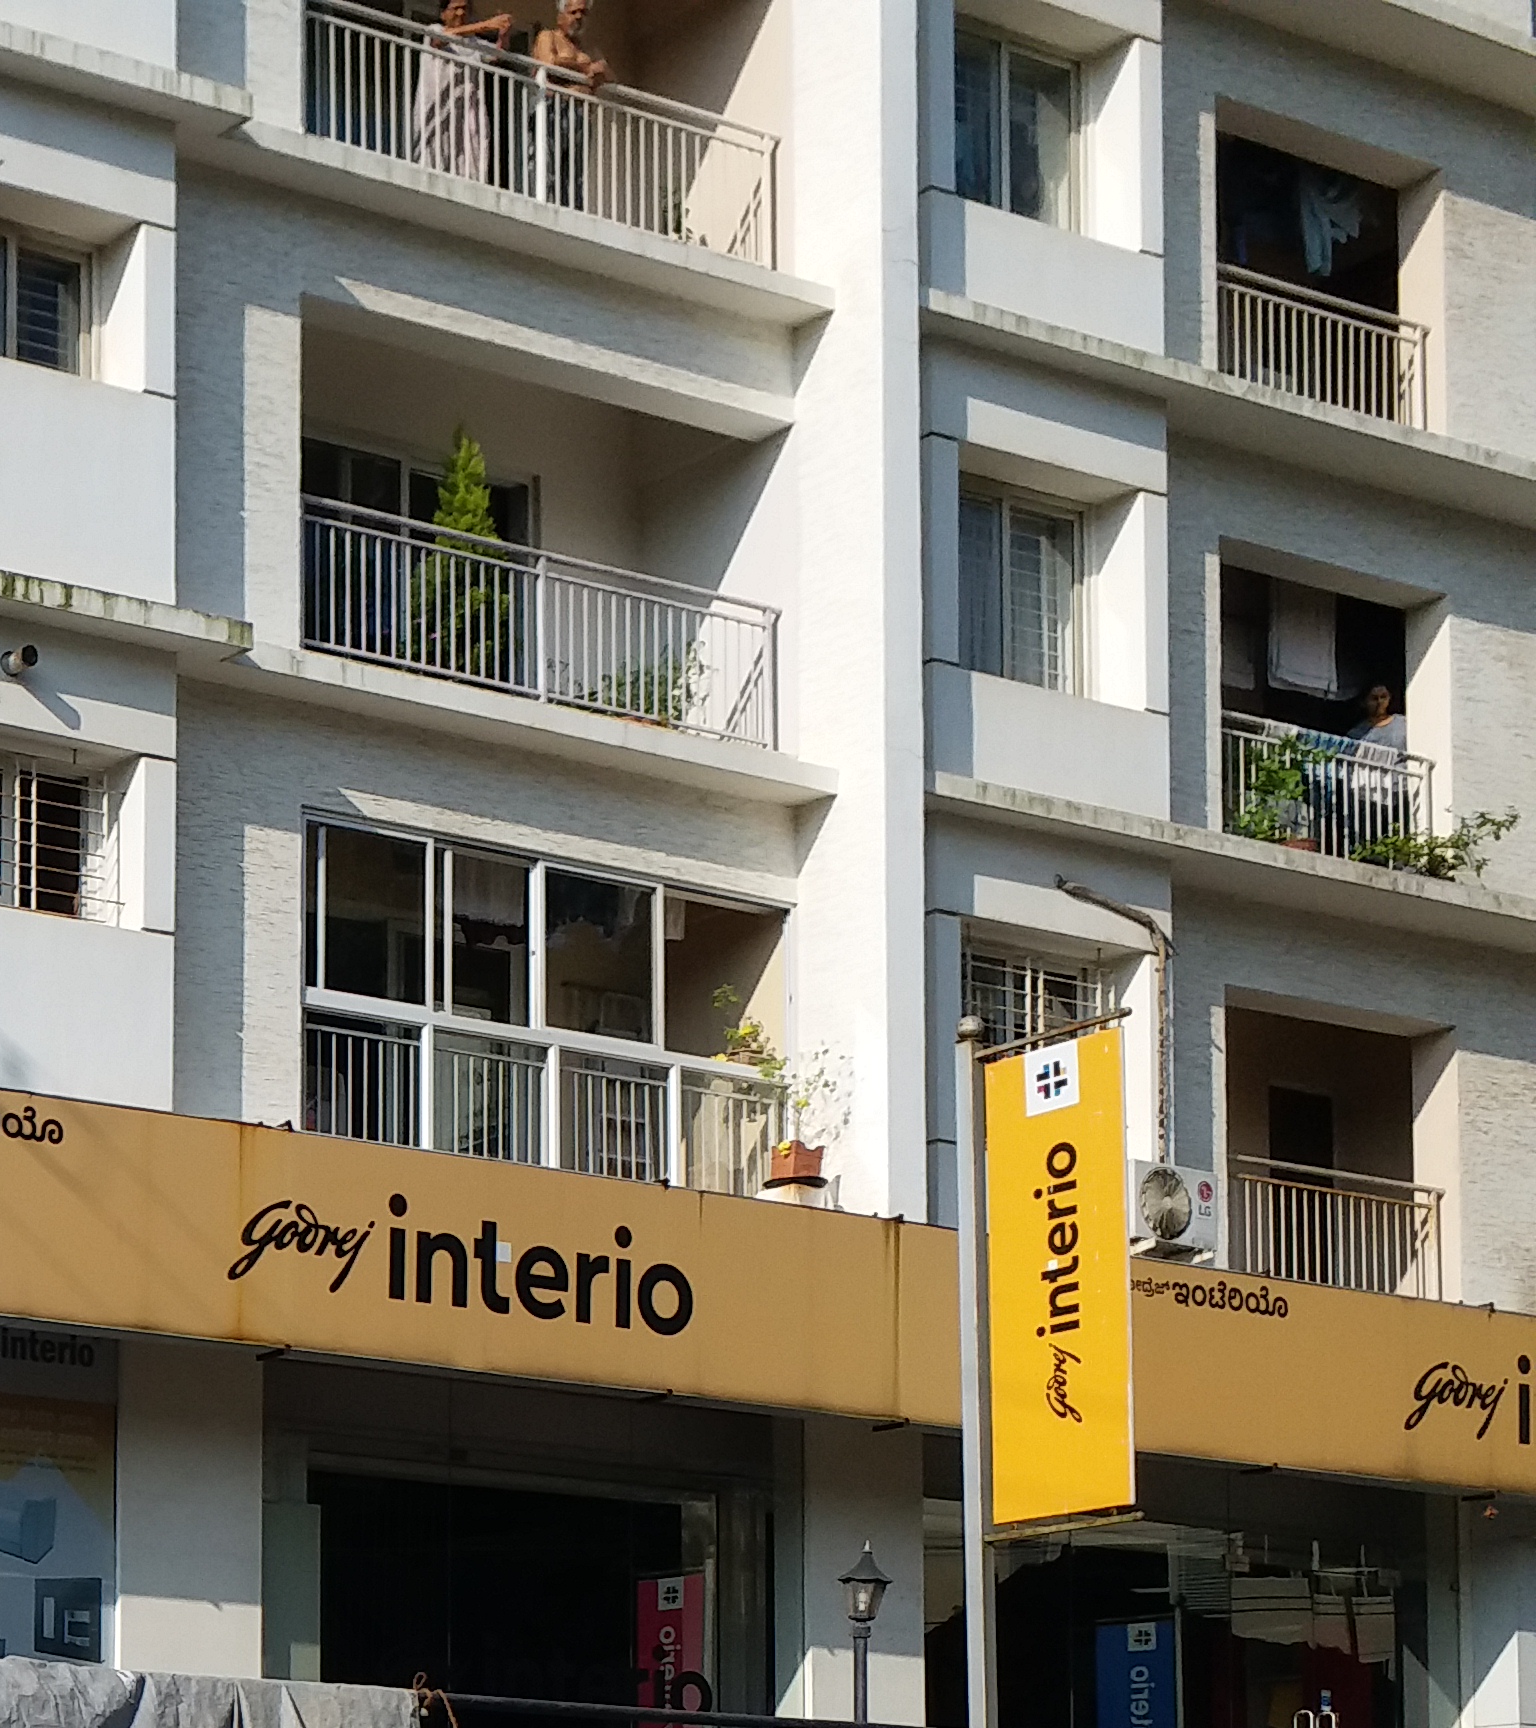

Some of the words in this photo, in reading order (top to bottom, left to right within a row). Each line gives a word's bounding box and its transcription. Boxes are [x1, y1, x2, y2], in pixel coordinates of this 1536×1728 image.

[1033, 1141, 1081, 1338] interio
[1198, 1204, 1212, 1218] LG
[227, 1199, 375, 1294] Godrej
[388, 1193, 694, 1336] interio
[0, 1327, 95, 1368] interio
[1045, 1342, 1083, 1423] Godrej
[1403, 1361, 1509, 1441] Godrej
